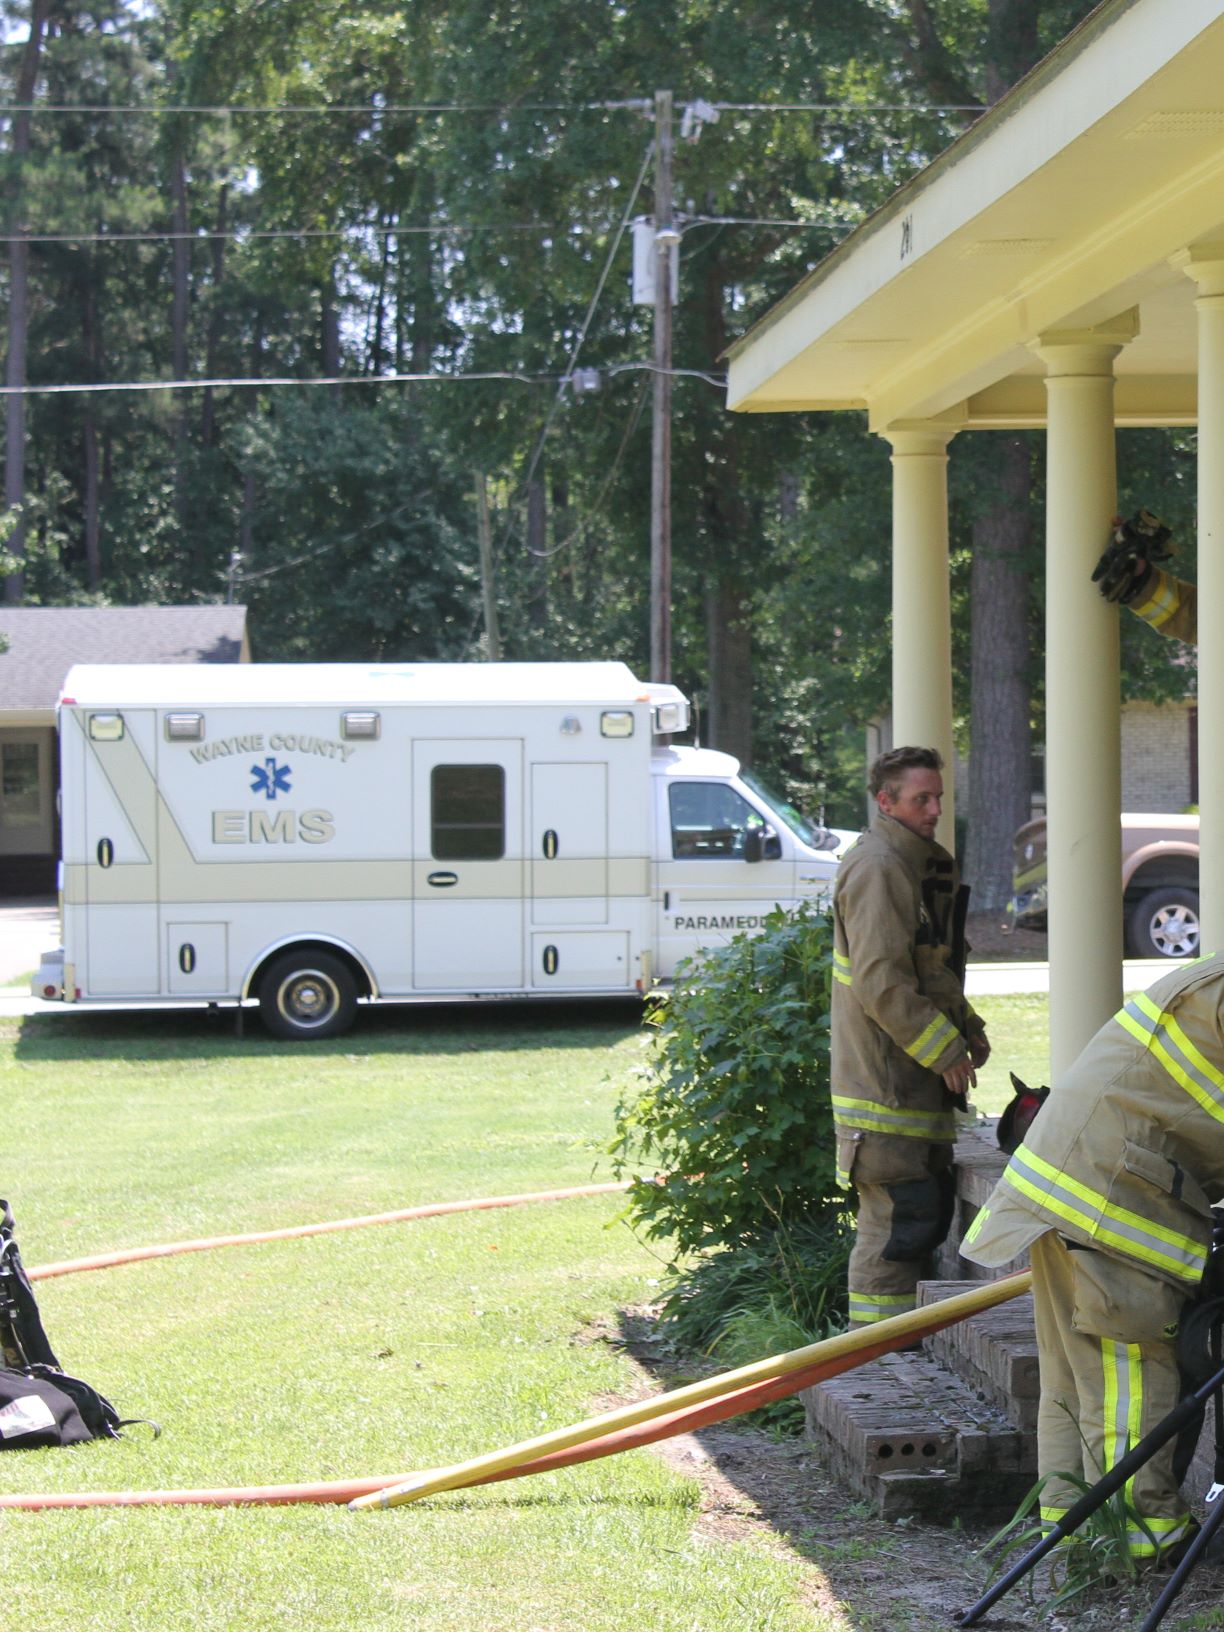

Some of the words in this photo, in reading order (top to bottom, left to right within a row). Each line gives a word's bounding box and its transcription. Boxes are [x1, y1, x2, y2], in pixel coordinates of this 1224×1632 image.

[189, 734, 265, 764] WAYNE
[268, 733, 357, 763] COUNTY
[212, 809, 336, 845] EMS
